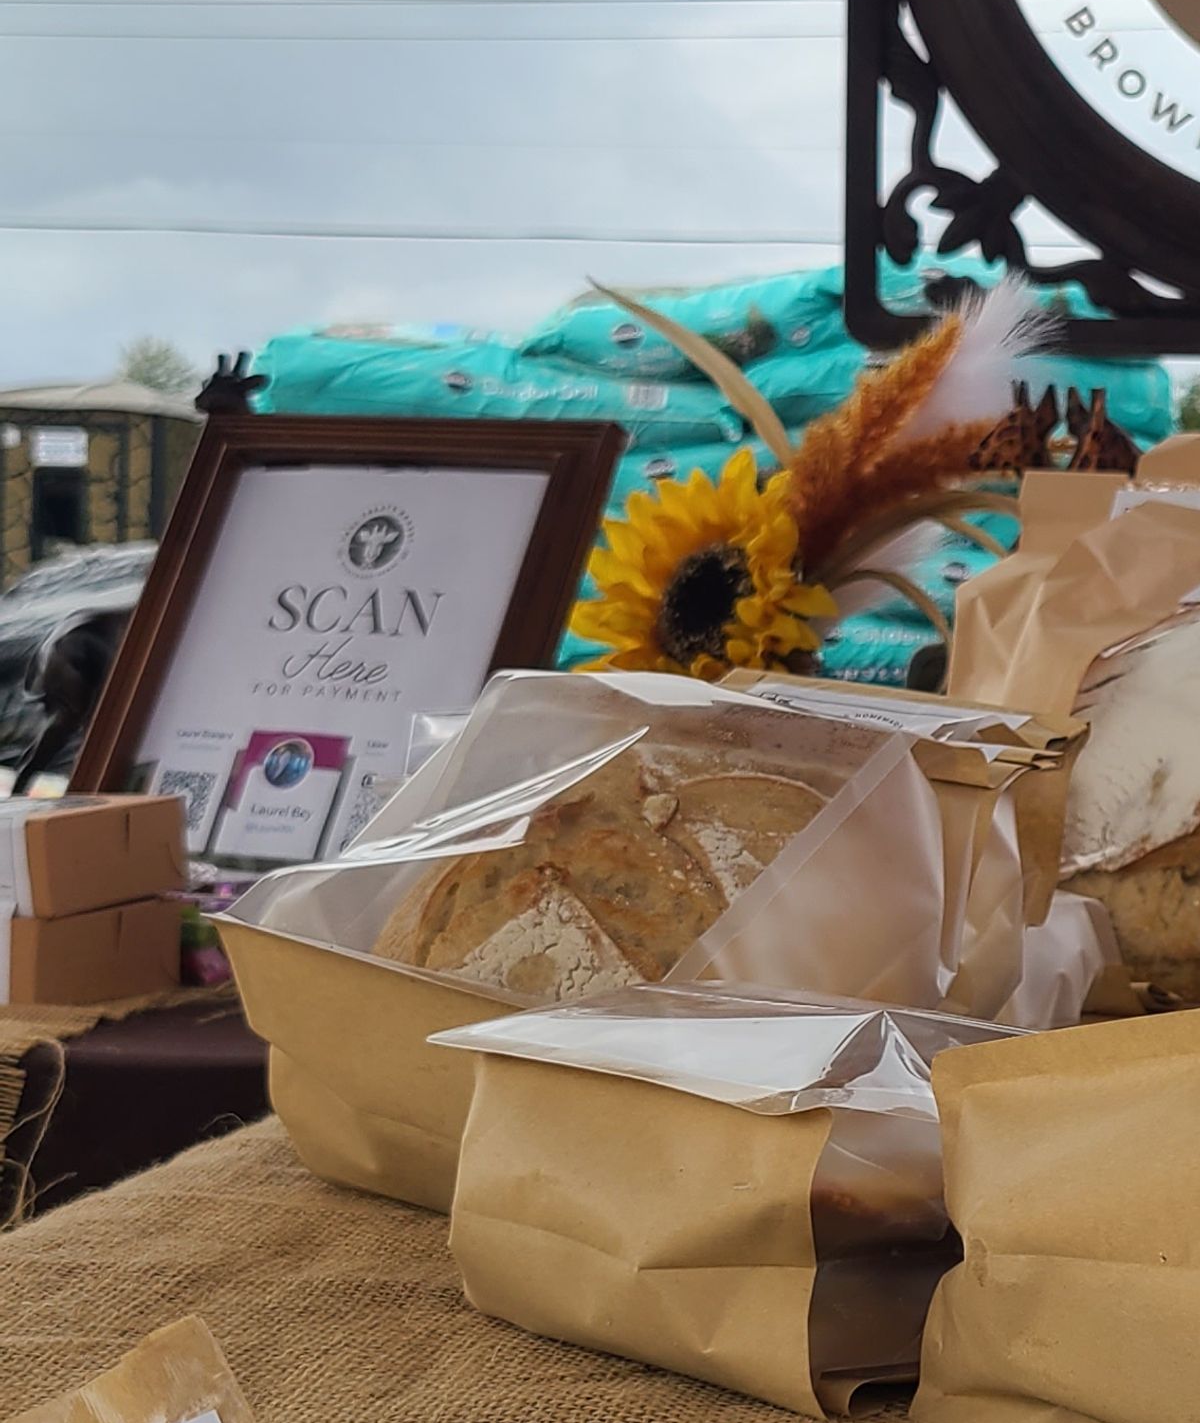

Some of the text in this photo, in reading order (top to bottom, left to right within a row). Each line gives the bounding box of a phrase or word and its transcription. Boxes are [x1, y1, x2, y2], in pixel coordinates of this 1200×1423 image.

[269, 584, 446, 637] SCAN
[282, 636, 388, 684] Here
[252, 683, 402, 702] FOR PAYMENT
